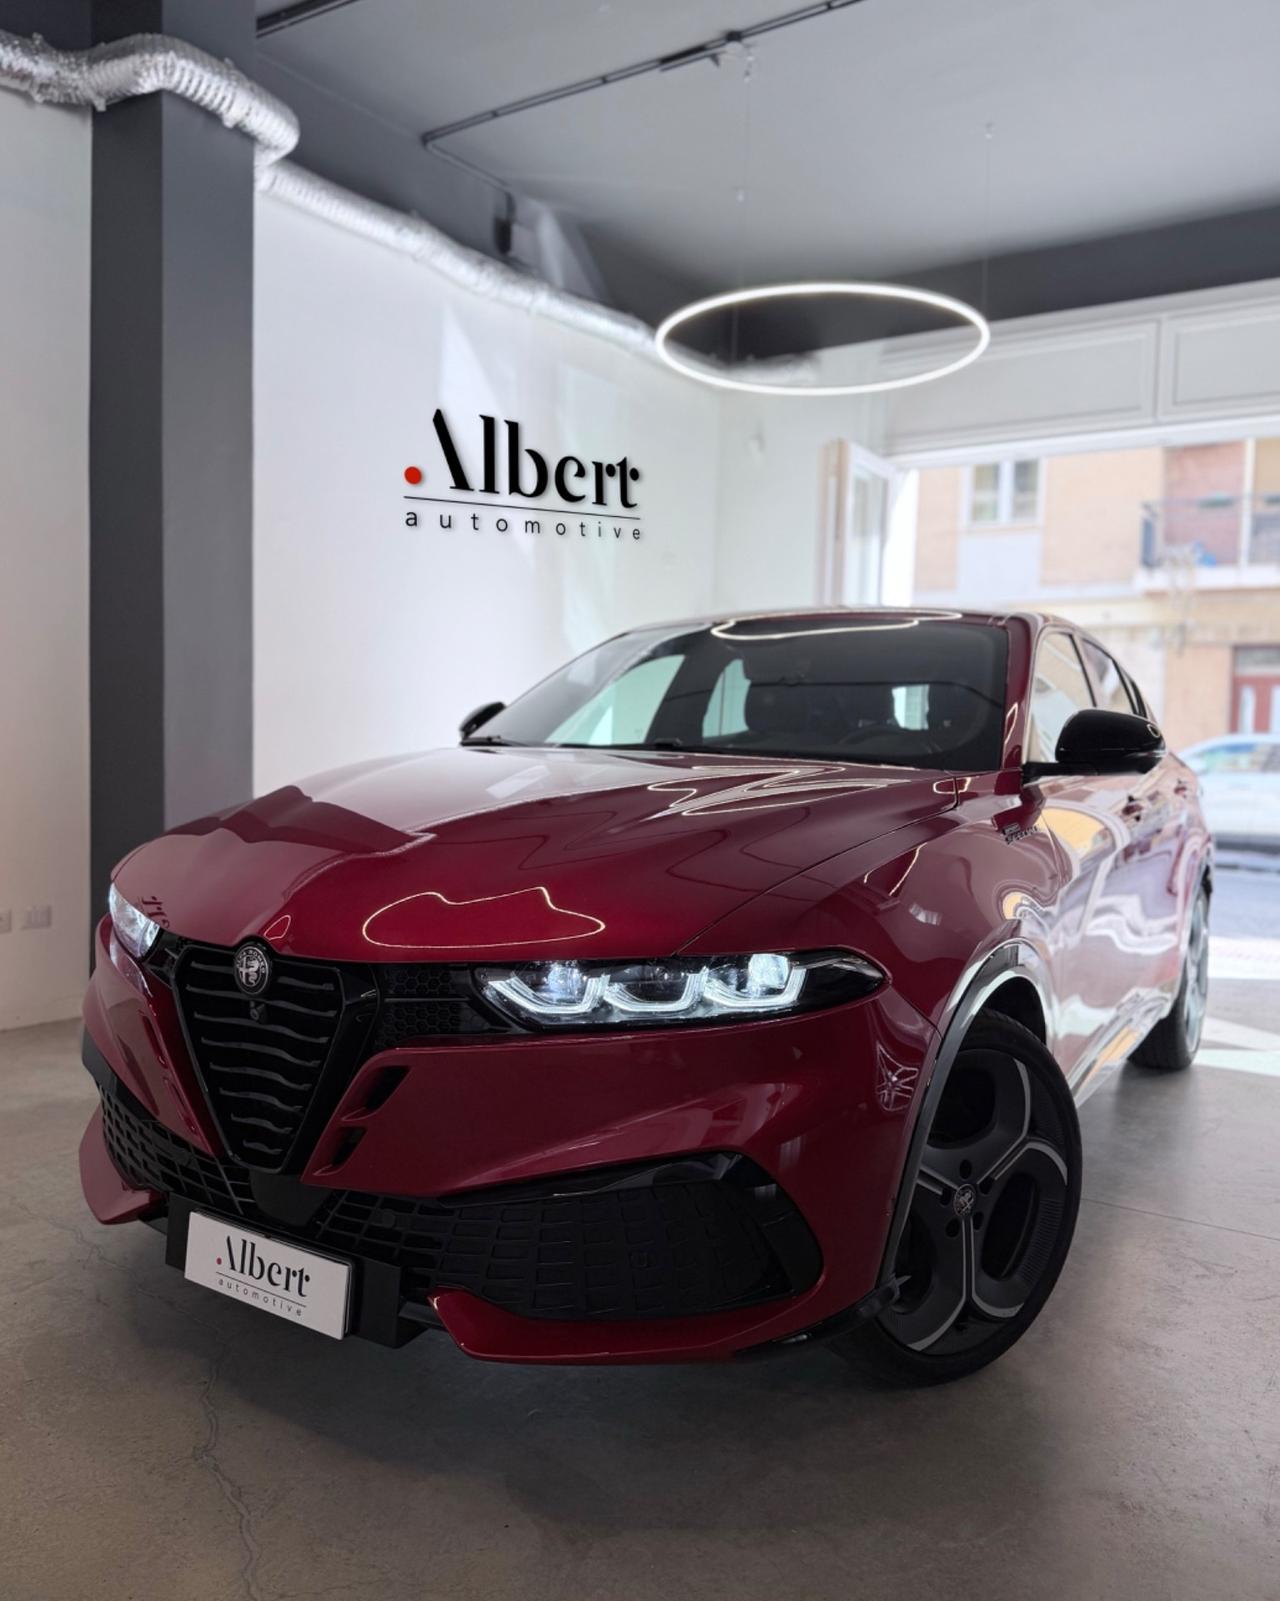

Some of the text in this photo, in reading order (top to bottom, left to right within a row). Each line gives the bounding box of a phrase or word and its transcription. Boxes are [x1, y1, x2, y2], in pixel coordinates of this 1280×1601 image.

[404, 408, 640, 508] Albert
[404, 511, 641, 540] automotive
[216, 1235, 310, 1297] Albert
[218, 1279, 302, 1316] automotive
